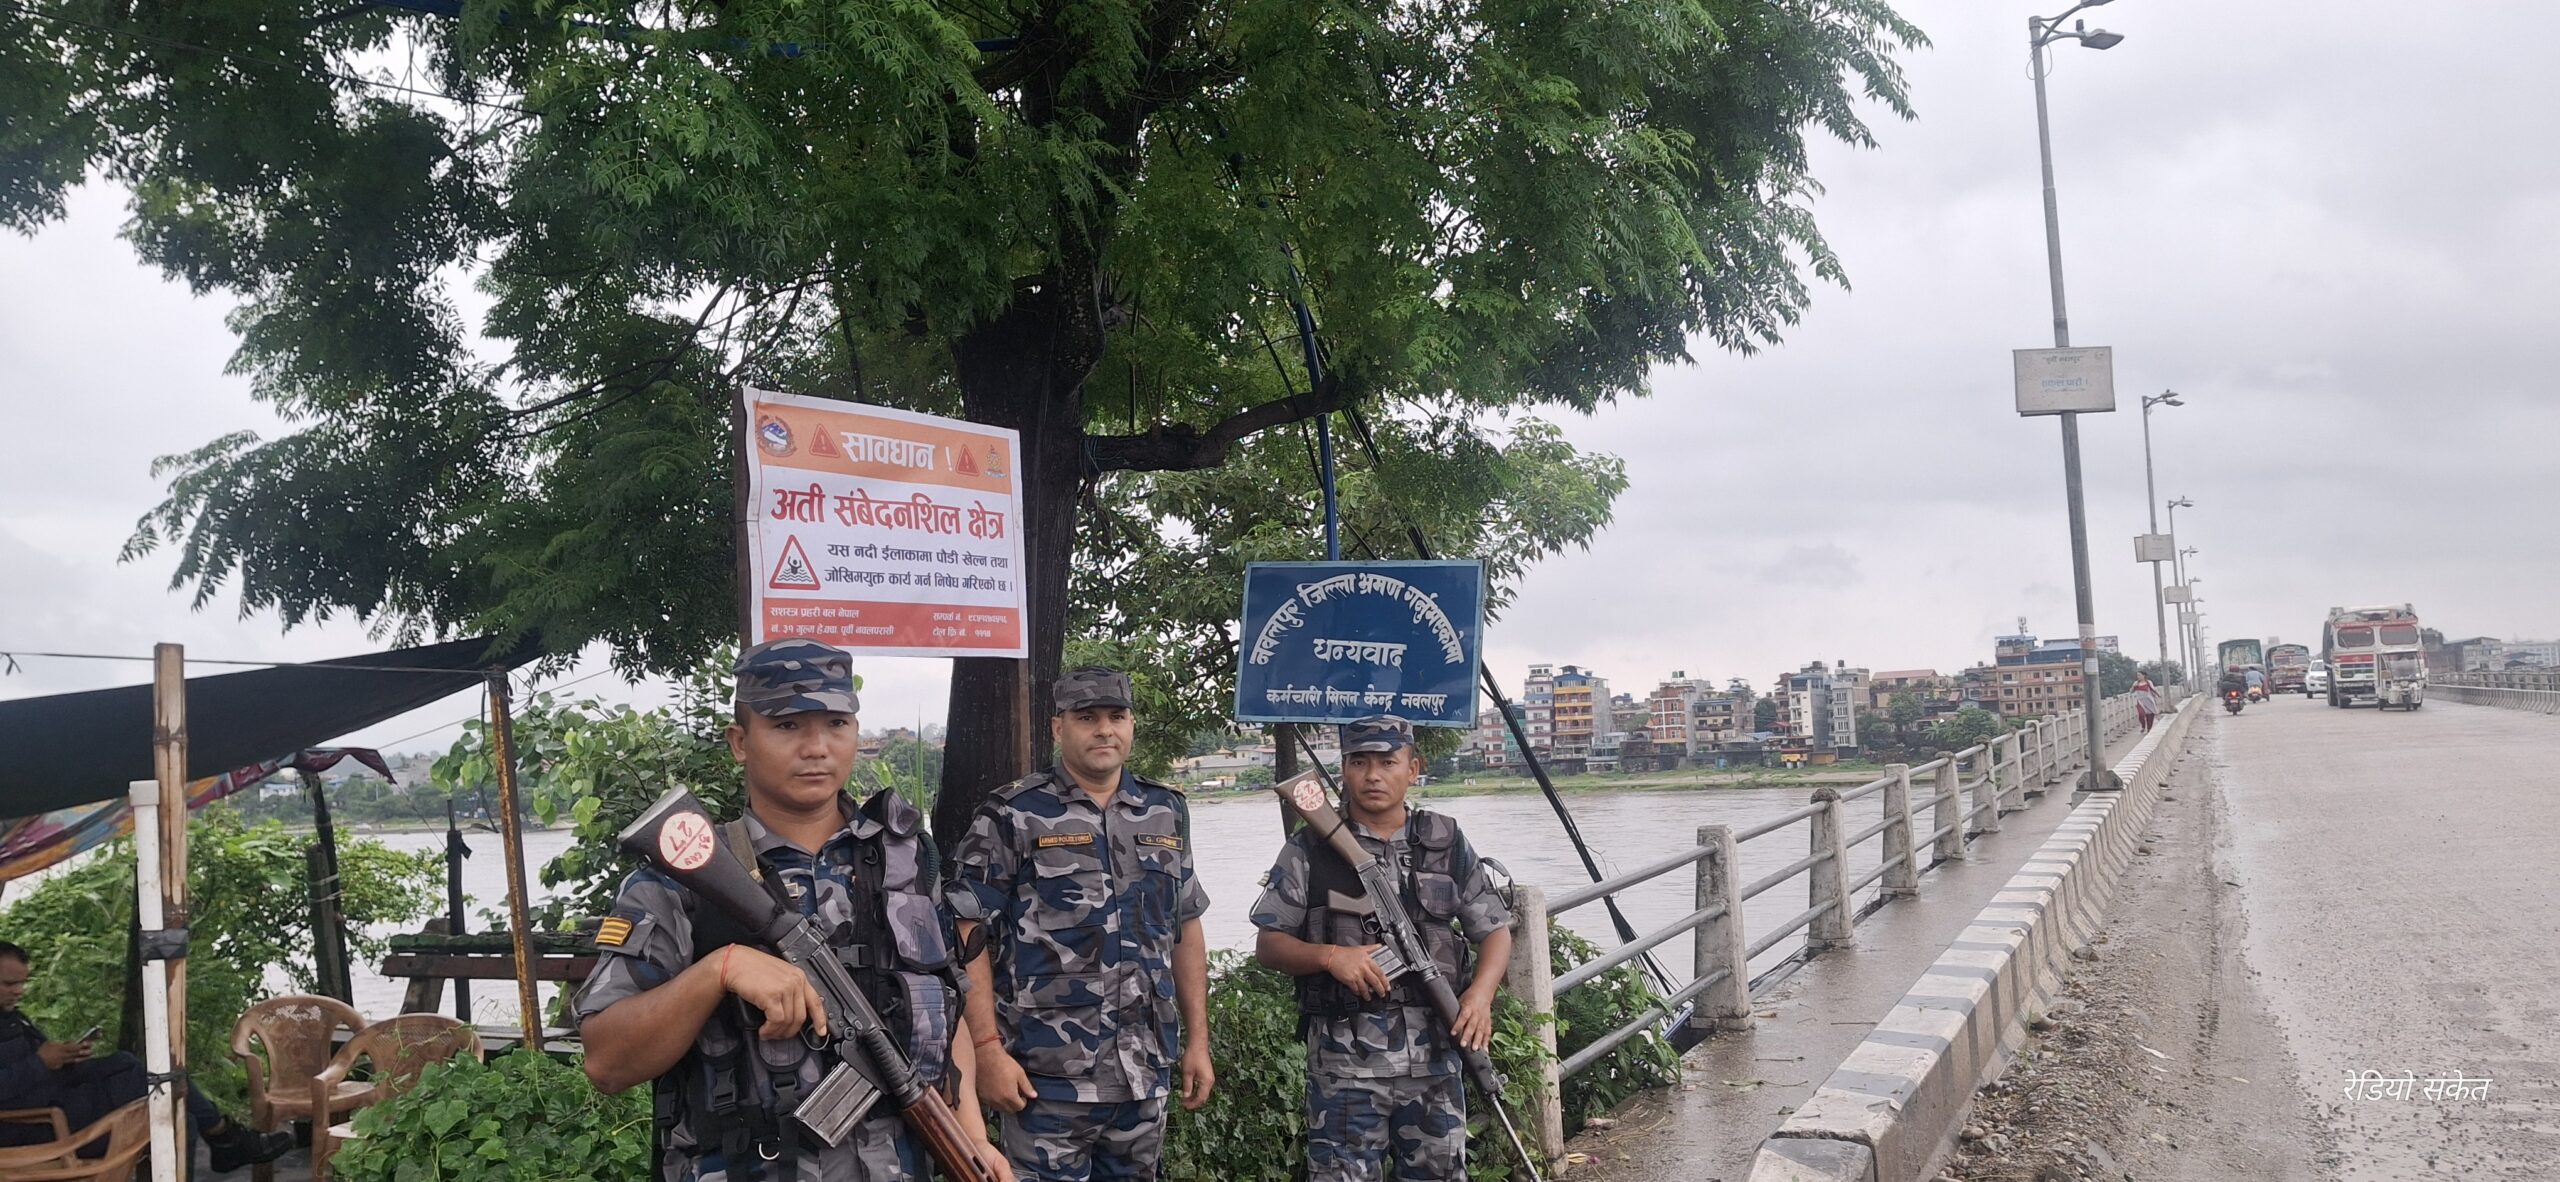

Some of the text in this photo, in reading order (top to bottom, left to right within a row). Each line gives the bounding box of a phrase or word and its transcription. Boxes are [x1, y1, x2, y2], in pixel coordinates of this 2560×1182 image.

[840, 431, 936, 471] सावधान
[770, 482, 1005, 541] अती संबेदनशिल क्षेत्र
[827, 544, 850, 557] यस
[853, 543, 878, 559] नदी
[881, 544, 933, 562] ईलाकामा
[962, 550, 987, 567] खेल्न
[990, 556, 1009, 569] तथा
[824, 566, 885, 587] जोखिमयुक्त
[888, 571, 911, 586] कार्य
[914, 572, 931, 587] गर्न
[934, 572, 959, 588] निषेध
[962, 574, 996, 591] गरिएको
[770, 607, 798, 617] सशस्त्र
[800, 606, 820, 618] प्रहरी
[838, 607, 860, 618] नेपाल
[1249, 598, 1307, 665] नवलपुर
[1296, 573, 1356, 608] जिल्ला
[1358, 572, 1405, 601] भ्रमण
[783, 625, 794, 634] ३१
[1313, 638, 1407, 673] धन्यवाद
[1266, 683, 1447, 716] कर्मचारी मिलन केन्द्र नवलपुर
[669, 821, 692, 851] 27
